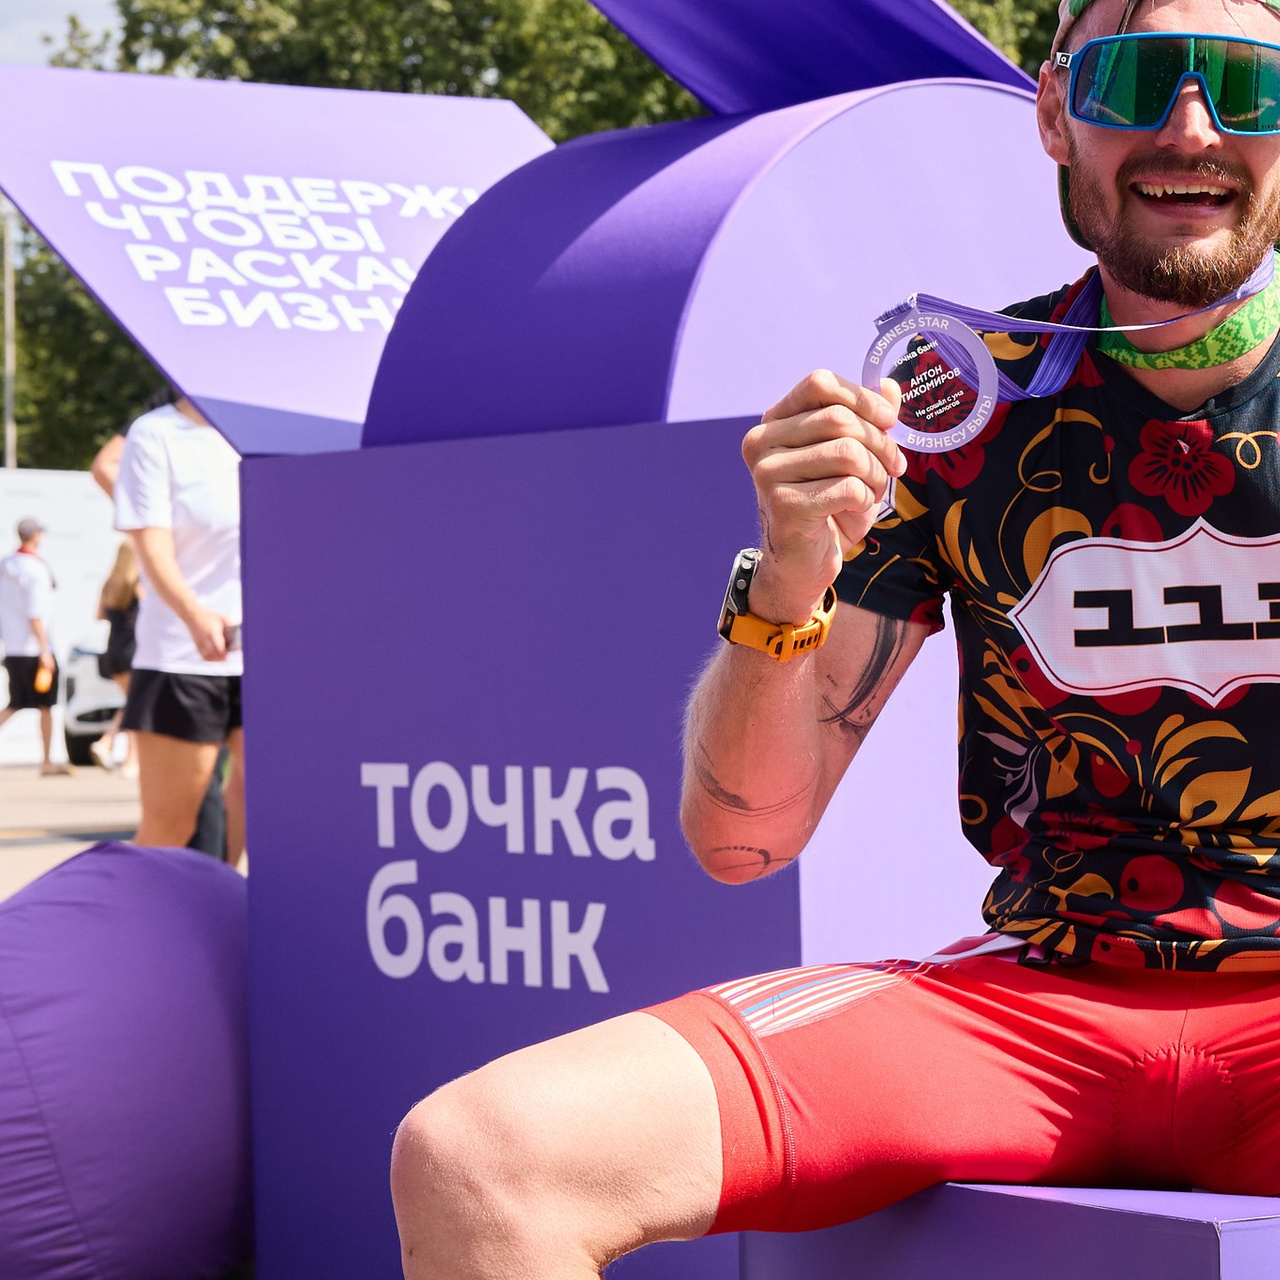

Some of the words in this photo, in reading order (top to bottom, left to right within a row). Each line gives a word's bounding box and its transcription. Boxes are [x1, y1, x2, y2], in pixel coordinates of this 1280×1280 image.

[85, 201, 386, 253] ЧТОБЫ
[164, 286, 403, 333] БИЗН
[870, 319, 916, 365] BUSINESS
[918, 317, 949, 330] STAR
[893, 350, 918, 367] точка
[917, 340, 939, 354] банк
[901, 367, 961, 403] ТИХОМИРОВ
[910, 365, 943, 388] АНТОН
[907, 429, 966, 448] БИЗНЕСУ
[967, 395, 993, 433] БЫТЬ!
[915, 409, 926, 418] Не
[934, 400, 960, 416] налогов
[360, 761, 656, 862] точка
[366, 859, 610, 993] банк
